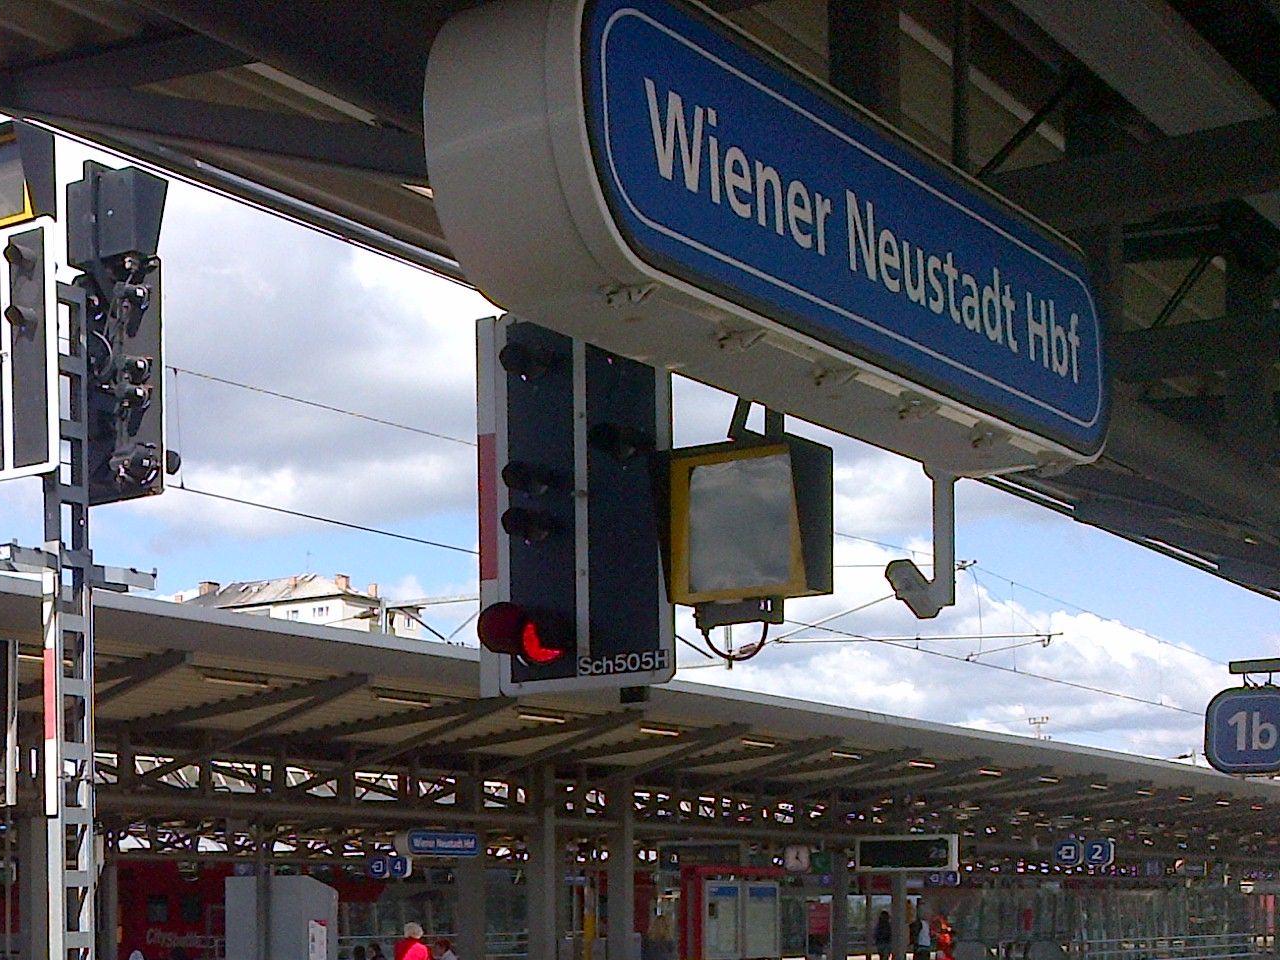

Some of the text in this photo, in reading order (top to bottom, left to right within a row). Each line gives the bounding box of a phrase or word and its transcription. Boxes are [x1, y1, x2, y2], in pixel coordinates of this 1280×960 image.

[644, 76, 1080, 385] Wiener Neustadt Hbf
[579, 649, 669, 675] Sch505H
[1227, 711, 1278, 751] 1b
[1091, 844, 1103, 860] 2
[394, 861, 402, 872] 4
